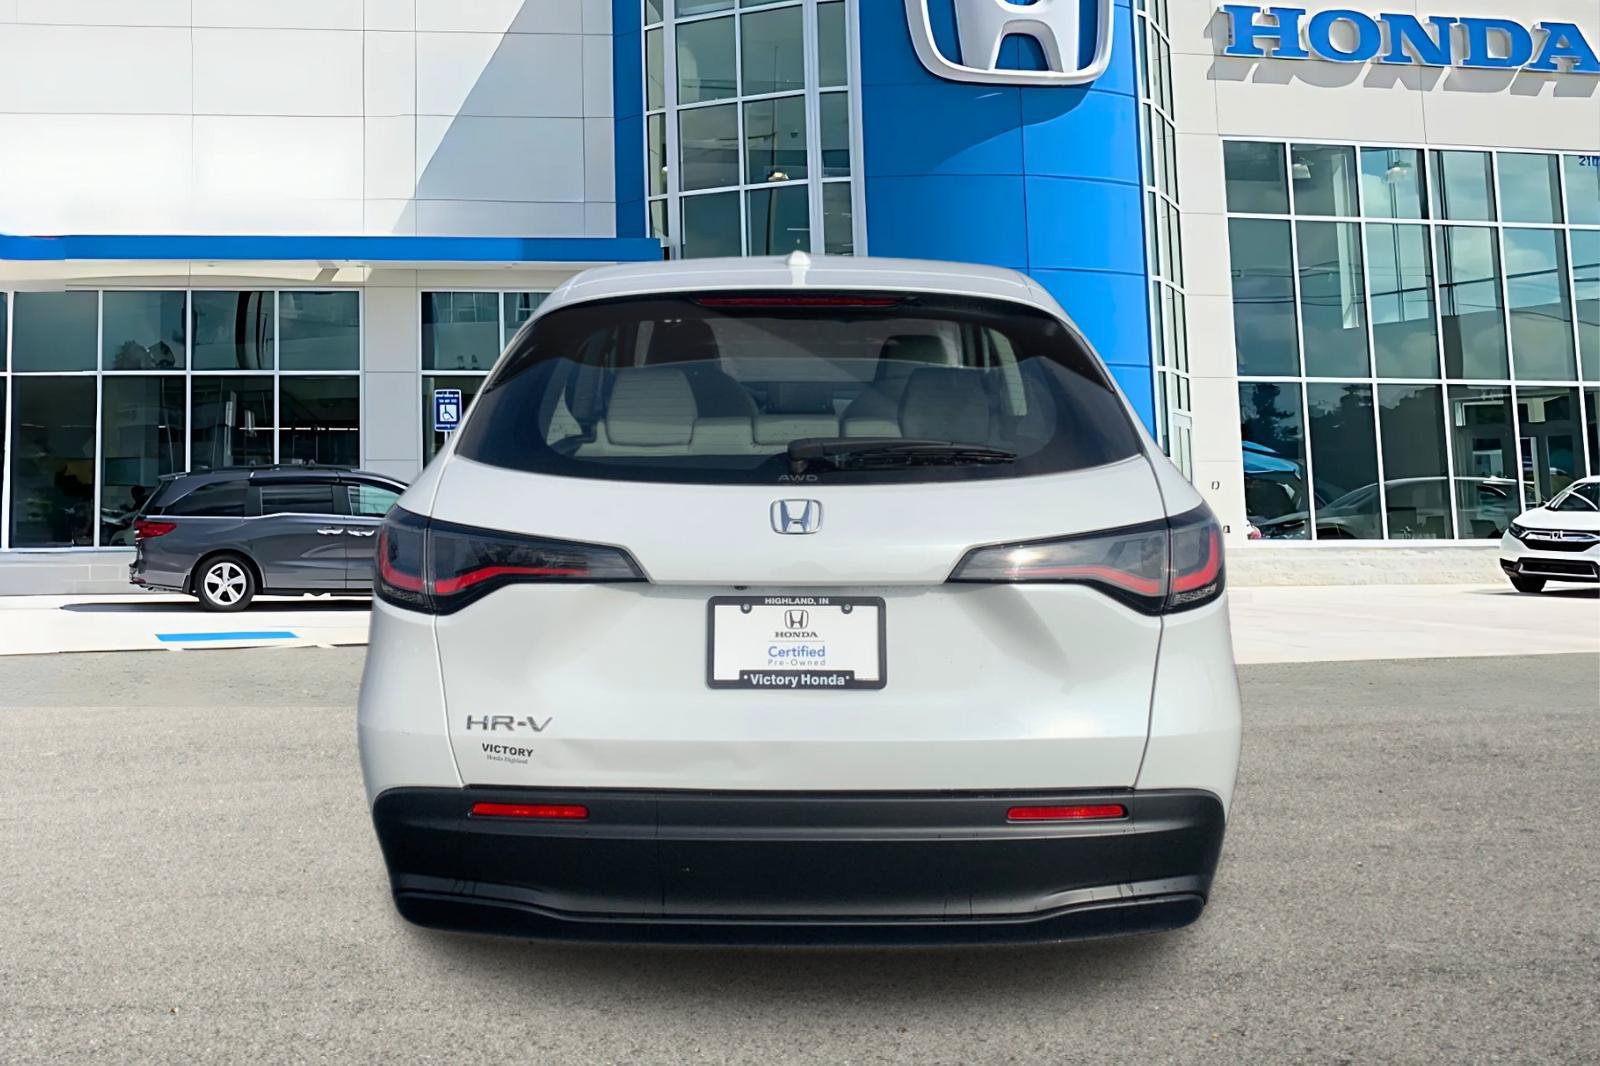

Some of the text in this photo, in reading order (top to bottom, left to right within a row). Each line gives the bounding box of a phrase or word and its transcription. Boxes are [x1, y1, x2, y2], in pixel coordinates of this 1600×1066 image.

[1221, 4, 1600, 74] HONDA
[778, 474, 819, 482] AWD
[764, 597, 817, 605] HIGHLAND,
[768, 645, 826, 657] Certified
[750, 674, 845, 688] Victory Honda
[466, 714, 553, 732] HR-V
[482, 742, 534, 757] VICTORY
